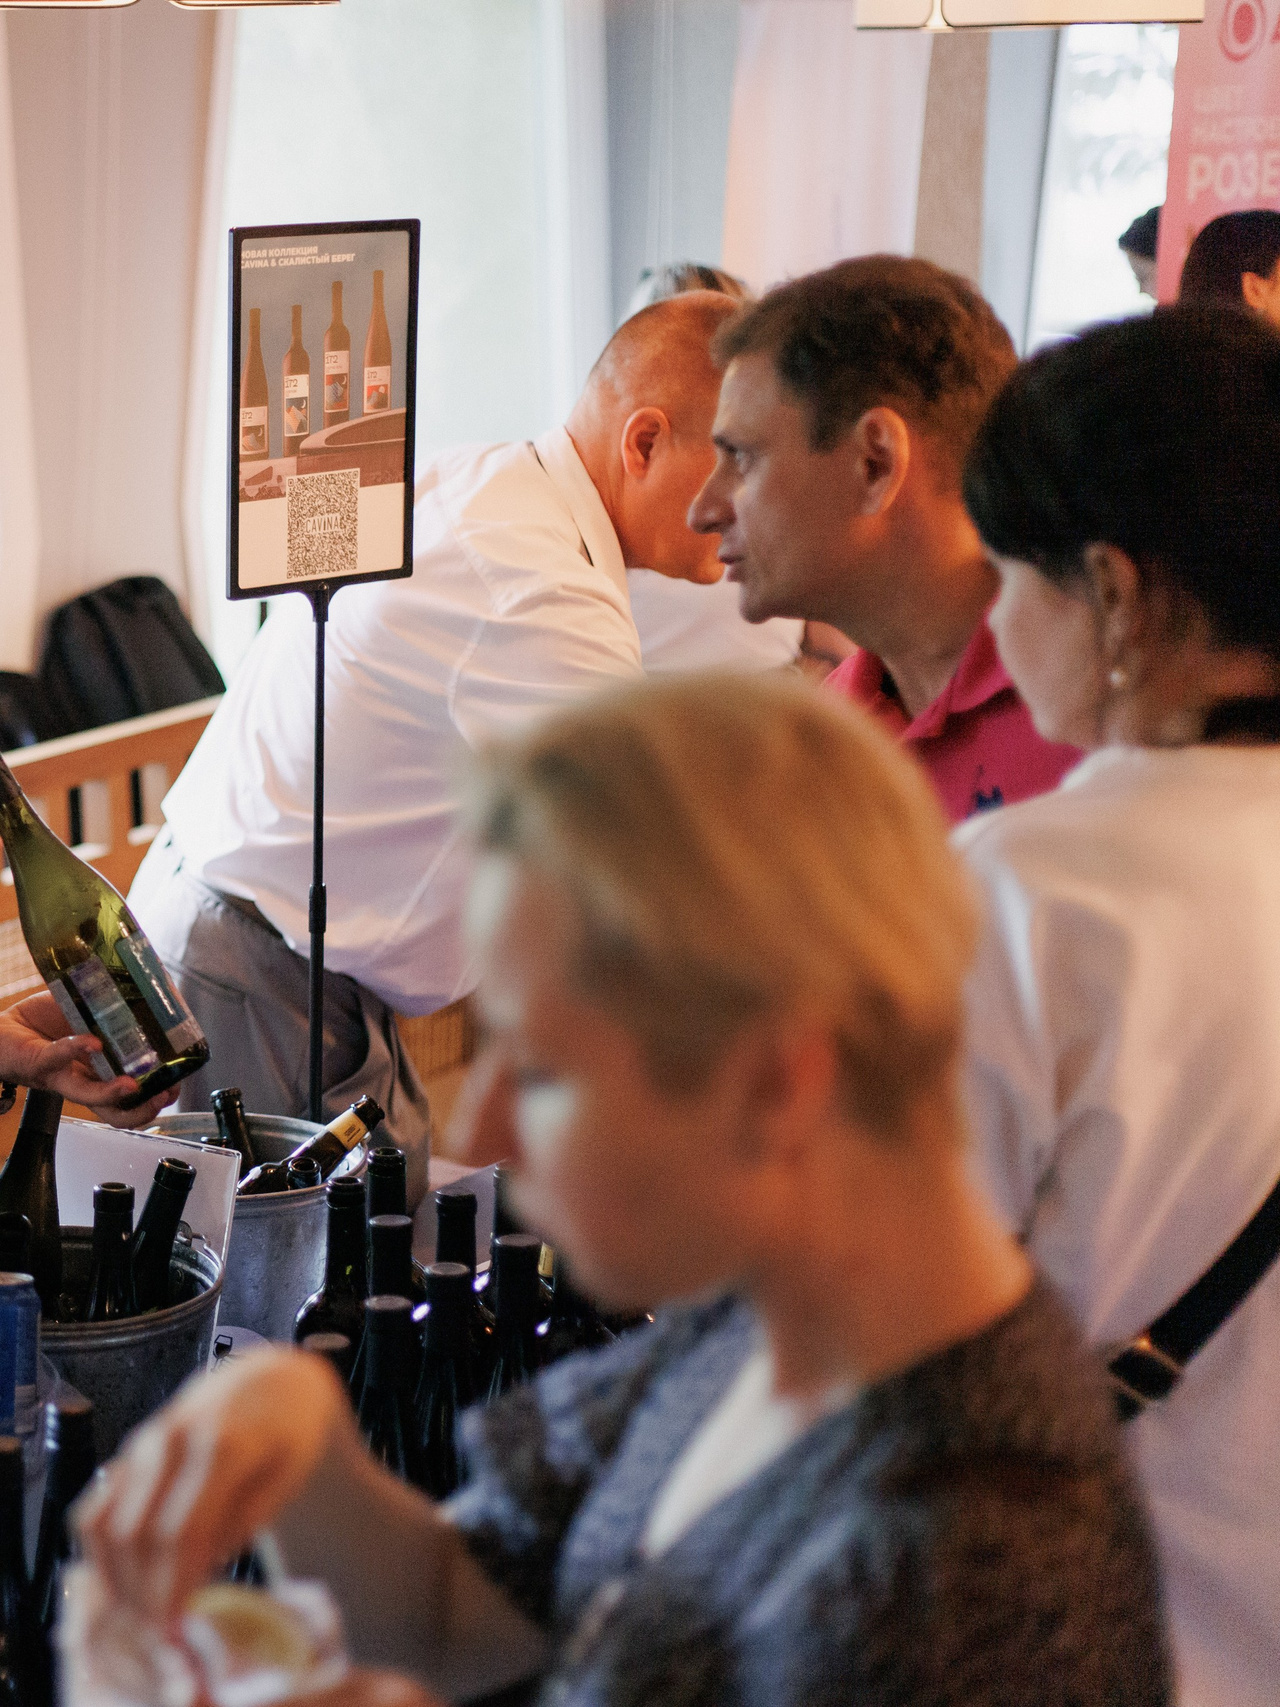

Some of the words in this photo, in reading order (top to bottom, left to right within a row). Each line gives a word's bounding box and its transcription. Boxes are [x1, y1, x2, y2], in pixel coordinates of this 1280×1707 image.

[268, 246, 318, 257] КОЛЛЕКЦИЯ
[278, 253, 330, 266] СКАЛИСТЫЙ
[331, 253, 356, 263] БЕРЕГ
[306, 516, 339, 533] CAVINA
